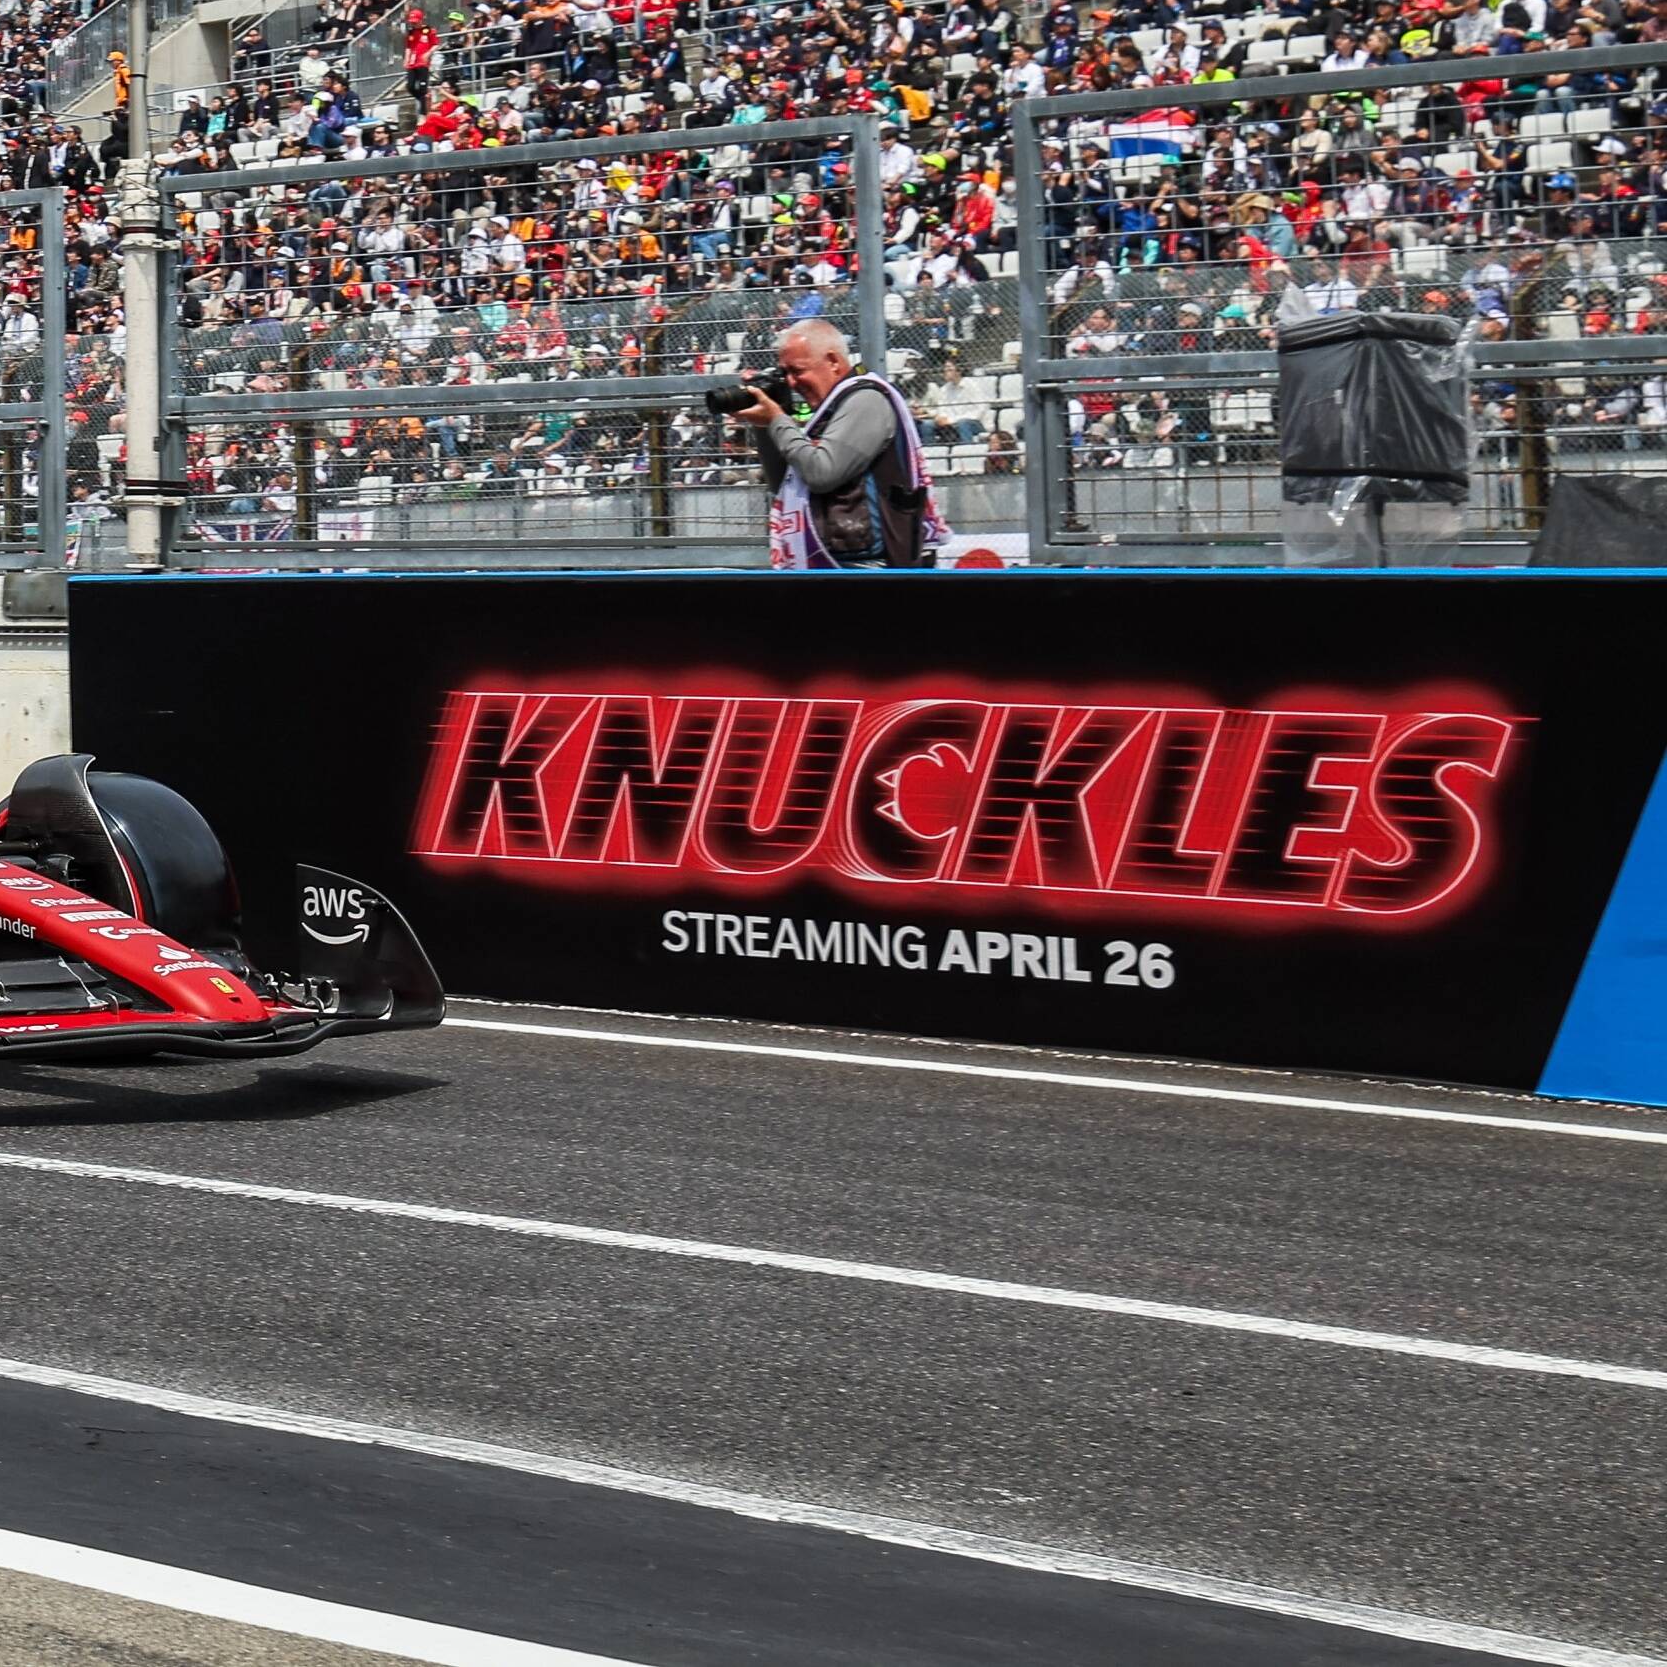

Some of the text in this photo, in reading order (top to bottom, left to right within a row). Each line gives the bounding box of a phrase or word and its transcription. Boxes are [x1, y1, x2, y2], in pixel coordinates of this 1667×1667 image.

[412, 691, 1511, 915] KNUCKLES
[303, 886, 366, 919] aws
[662, 910, 1176, 990] STREAMING APRIL 26
